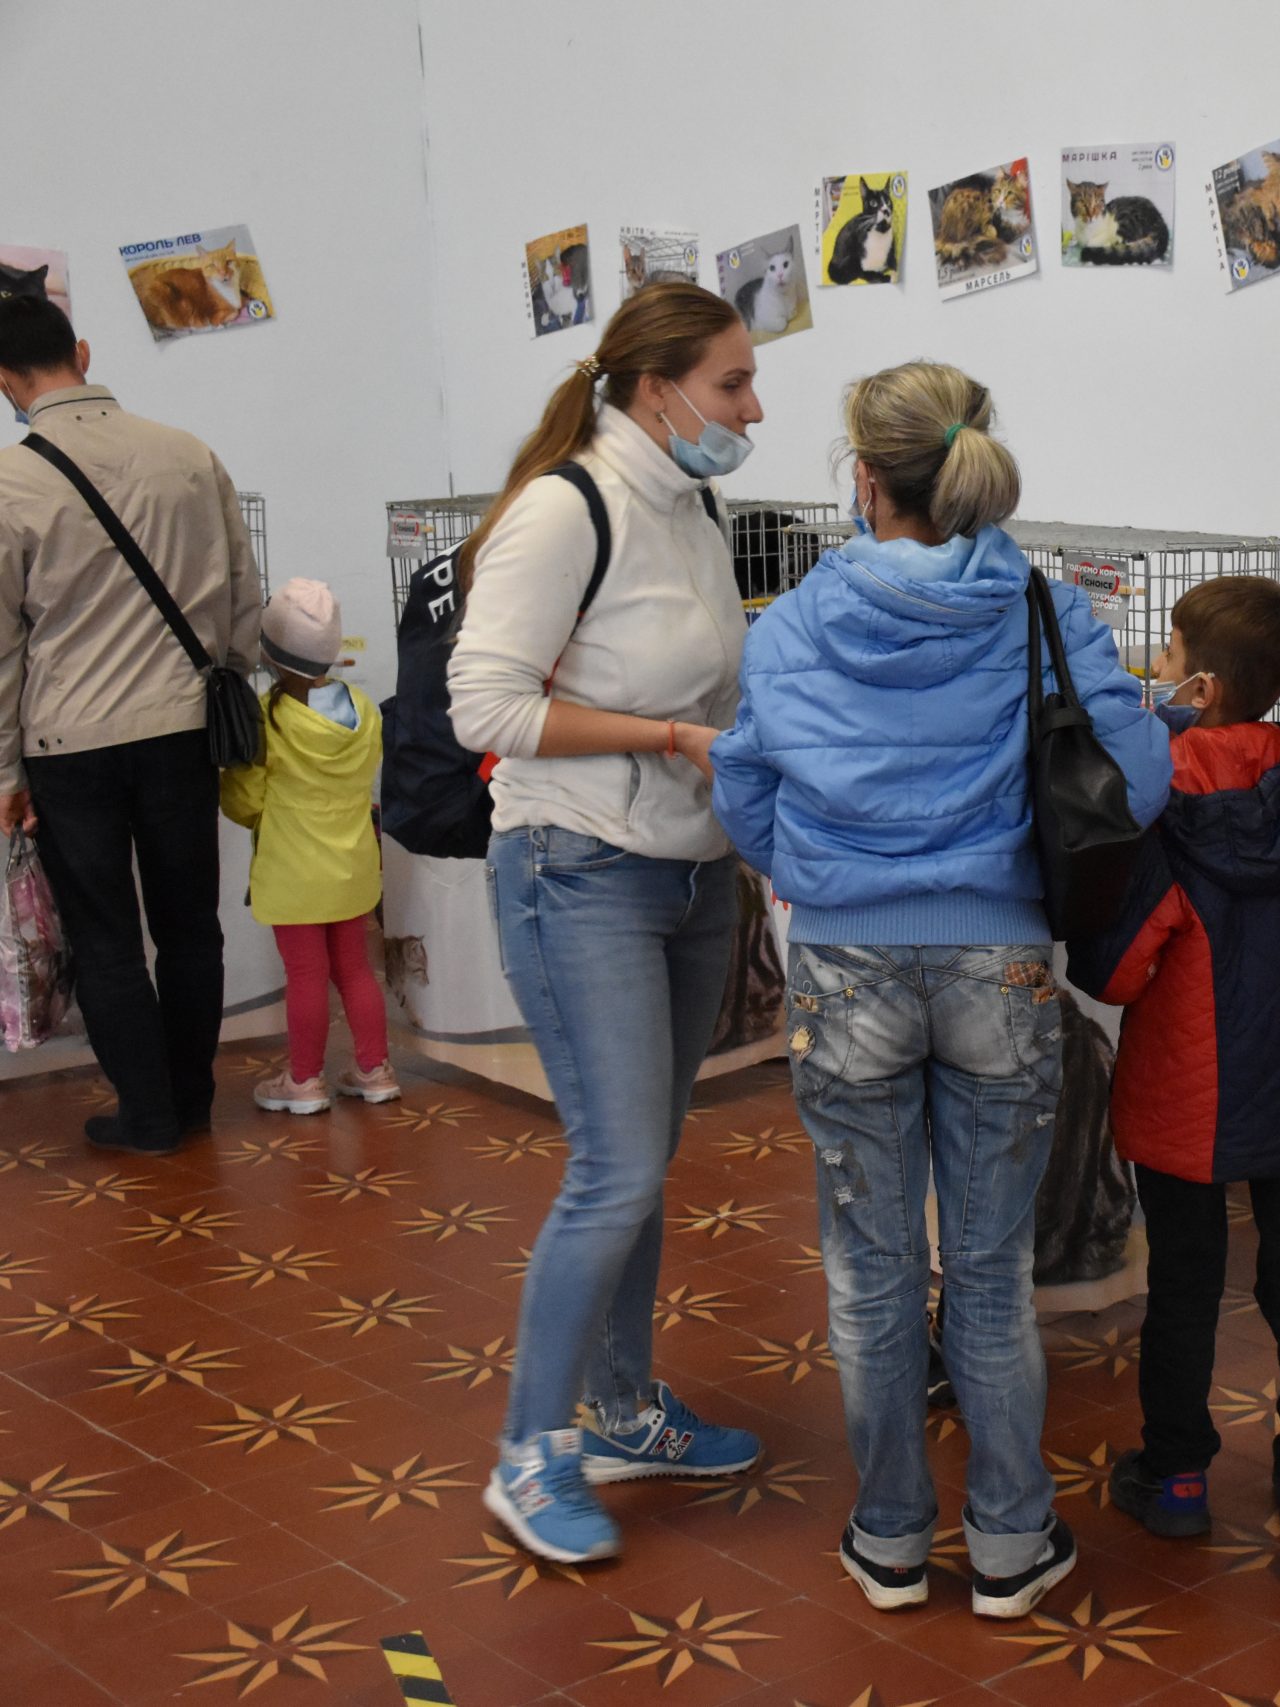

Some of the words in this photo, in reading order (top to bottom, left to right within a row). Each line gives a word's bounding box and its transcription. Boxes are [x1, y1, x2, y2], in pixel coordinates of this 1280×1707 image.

[1062, 152, 1117, 163] МАРІШКА
[1205, 183, 1225, 270] МАРКІЗА
[119, 239, 173, 257] КОРОЛЬ
[177, 233, 202, 247] ЛЕВ
[965, 271, 1011, 290] МАРСЕЛЬ
[1099, 568, 1126, 578] КОРМО
